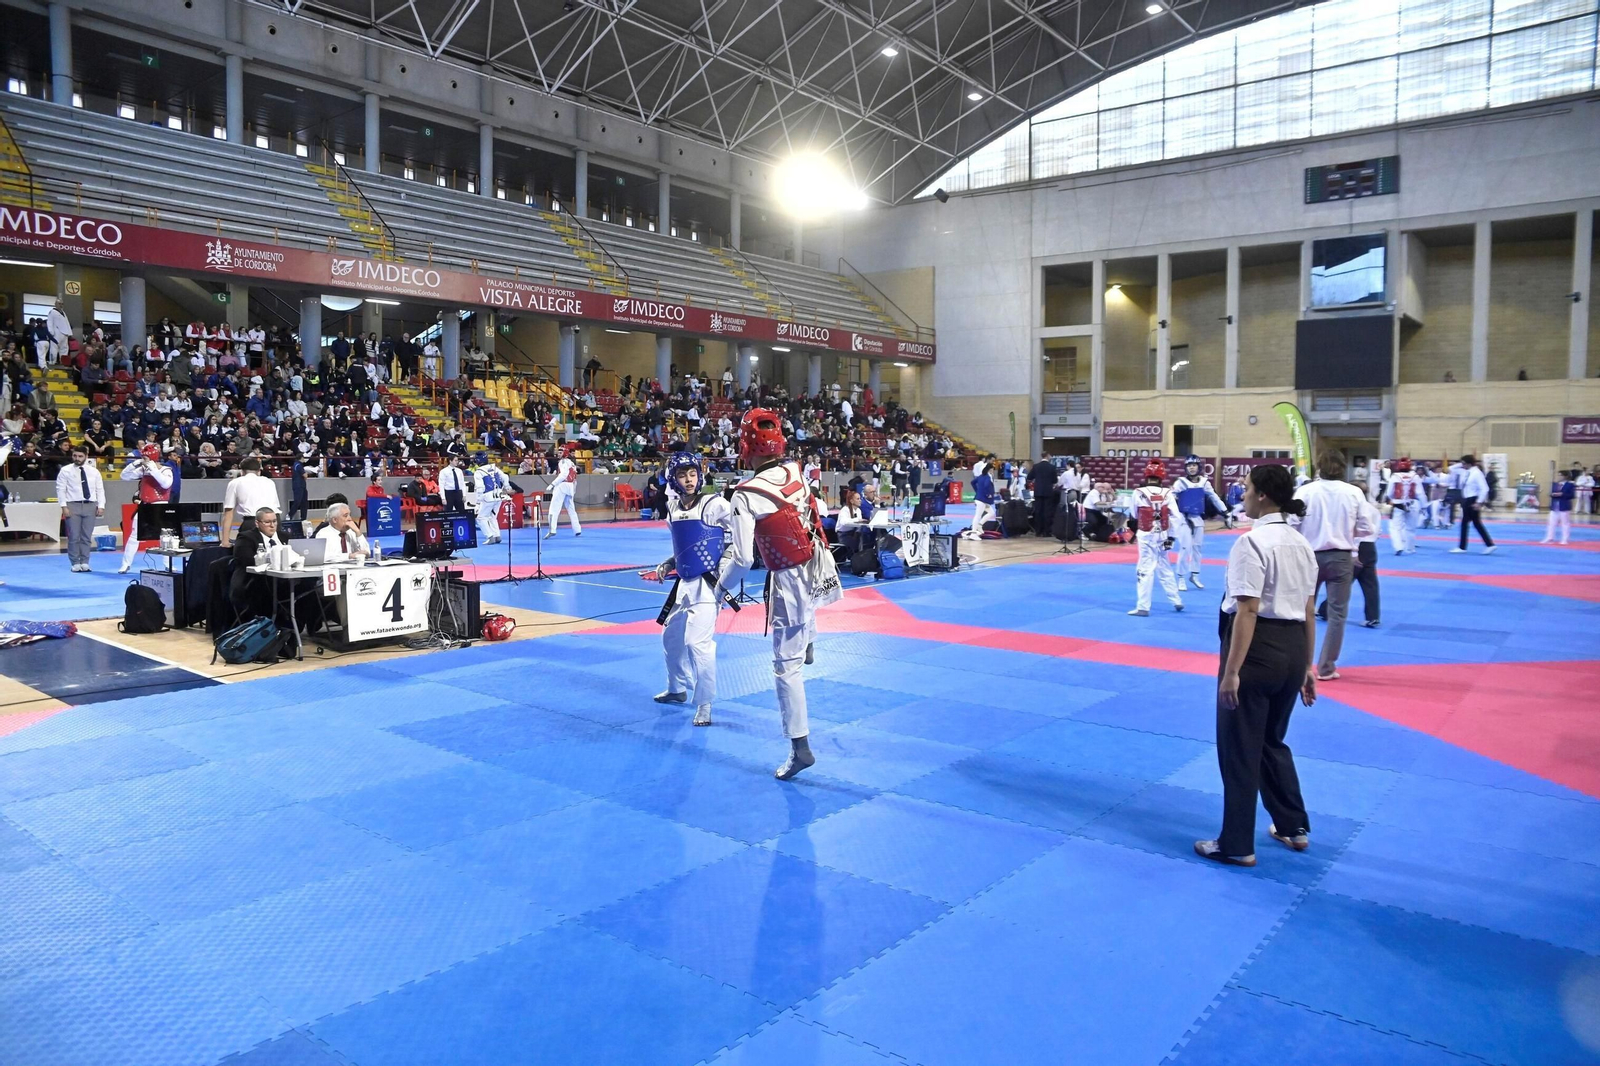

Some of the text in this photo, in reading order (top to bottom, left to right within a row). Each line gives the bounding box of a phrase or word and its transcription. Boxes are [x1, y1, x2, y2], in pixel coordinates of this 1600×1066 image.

[147, 56, 153, 65] 7
[425, 128, 431, 136] 8
[32, 239, 44, 247] de
[46, 241, 86, 252] Deportes
[87, 246, 122, 258] Córdoba
[234, 248, 284, 262] AYUNTAMIENTO
[234, 258, 277, 272] DE CÓRDOBA
[358, 260, 440, 288] IMDECO
[332, 278, 355, 287] Instituto
[356, 282, 384, 290] Municipal
[393, 286, 417, 295] Deportes
[418, 289, 440, 297] Córdoba
[486, 279, 576, 298] PALACIO MUNICIPAL DEPORTES
[218, 292, 226, 302] G
[480, 287, 583, 315] VISTA ALEGRE
[631, 300, 685, 321] IMDECO
[790, 324, 829, 341] IMDECO
[906, 342, 933, 356] IMDECO
[1118, 425, 1161, 435] IMDECO
[430, 528, 436, 538] 0
[458, 526, 464, 536] 0
[906, 526, 911, 539] 6
[910, 531, 918, 557] 3
[151, 578, 164, 588] TAPIZ
[328, 574, 336, 591] 8
[382, 578, 404, 622] 4
[360, 623, 422, 636] www.fataekwondo.org
